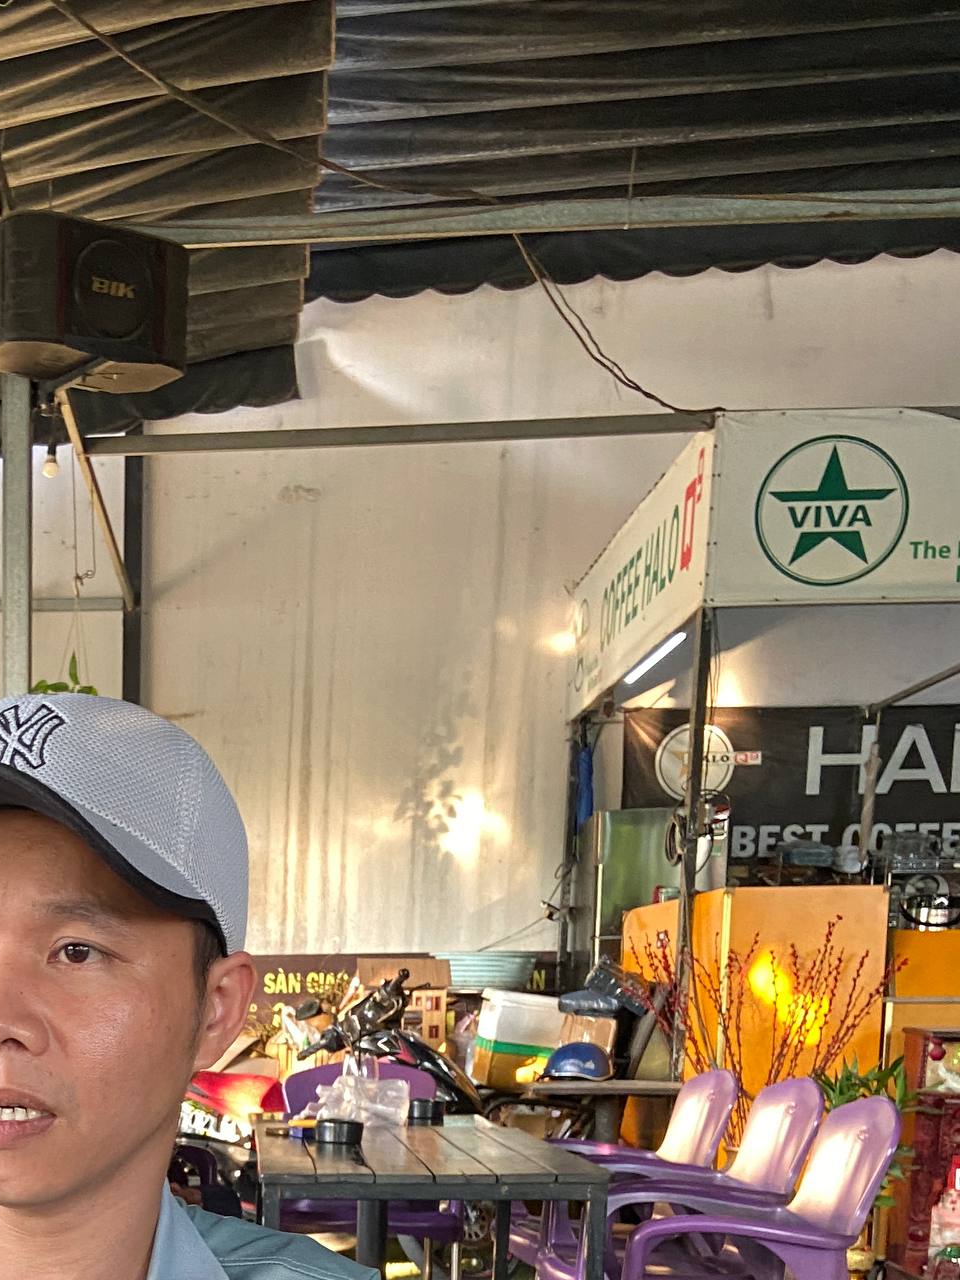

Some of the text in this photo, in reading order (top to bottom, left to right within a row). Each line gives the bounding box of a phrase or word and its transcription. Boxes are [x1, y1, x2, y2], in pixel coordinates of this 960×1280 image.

[787, 504, 873, 529] VIVA
[909, 540, 951, 560] The
[599, 546, 643, 654] COFFEE
[641, 503, 680, 612] HALO
[805, 723, 960, 796] HA
[263, 967, 302, 994] SÀN
